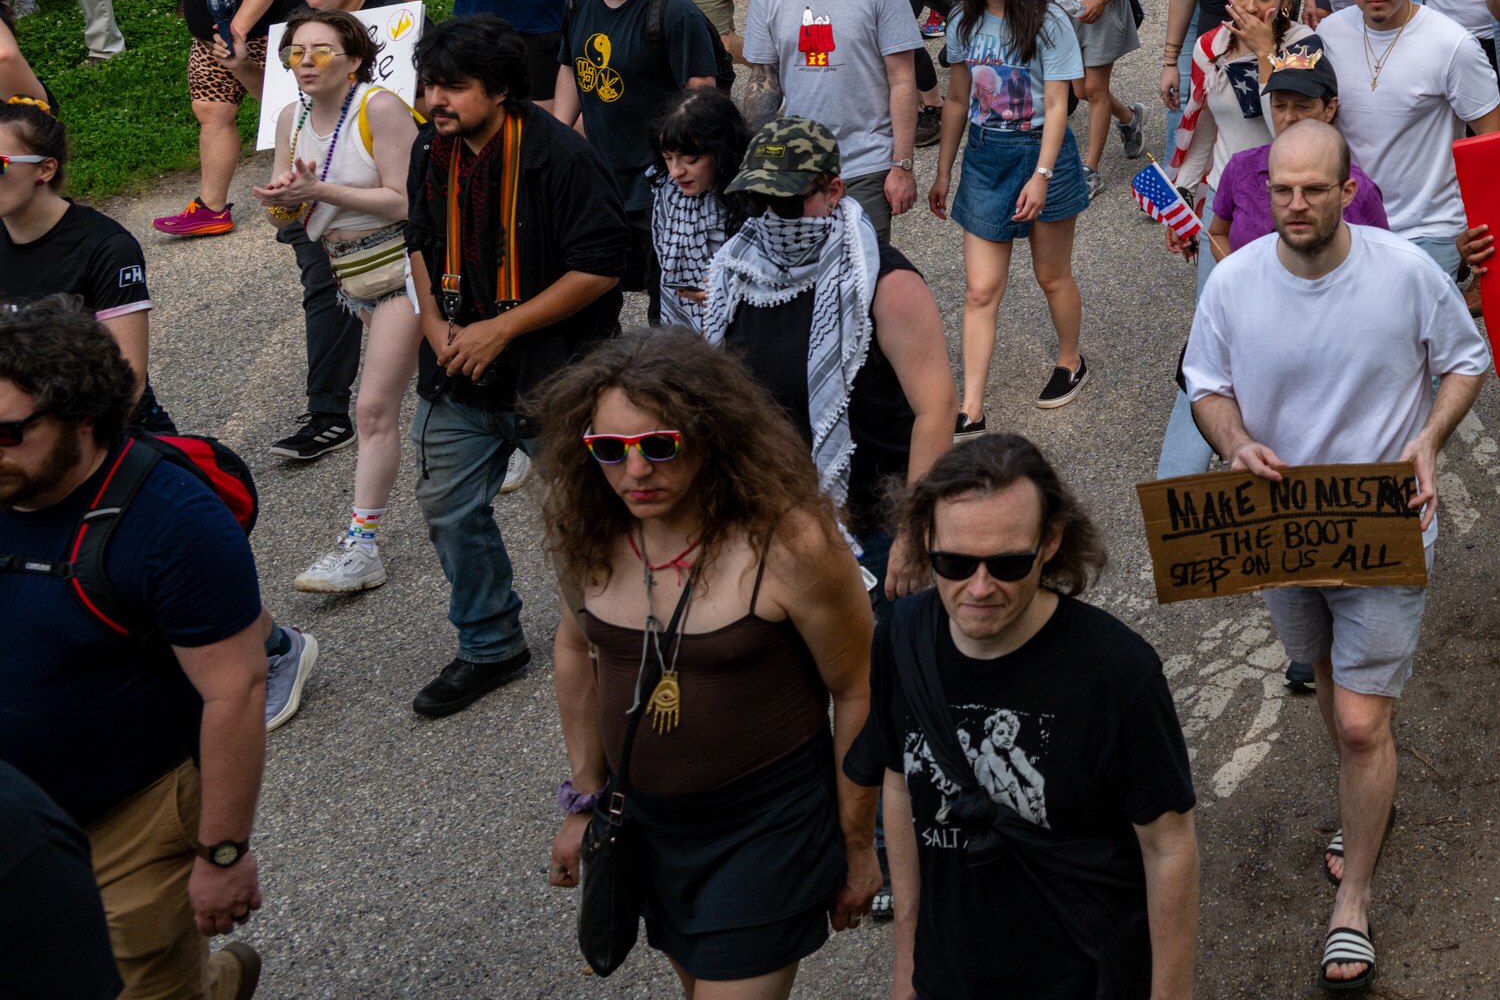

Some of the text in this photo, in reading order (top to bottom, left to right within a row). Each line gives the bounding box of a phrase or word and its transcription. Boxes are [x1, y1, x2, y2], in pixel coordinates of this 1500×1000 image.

[808, 52, 827, 65] it
[1166, 475, 1418, 532] MAKE NO MISTAKE
[1211, 518, 1357, 556] THE BOOT
[1242, 544, 1402, 576] ON US ALL
